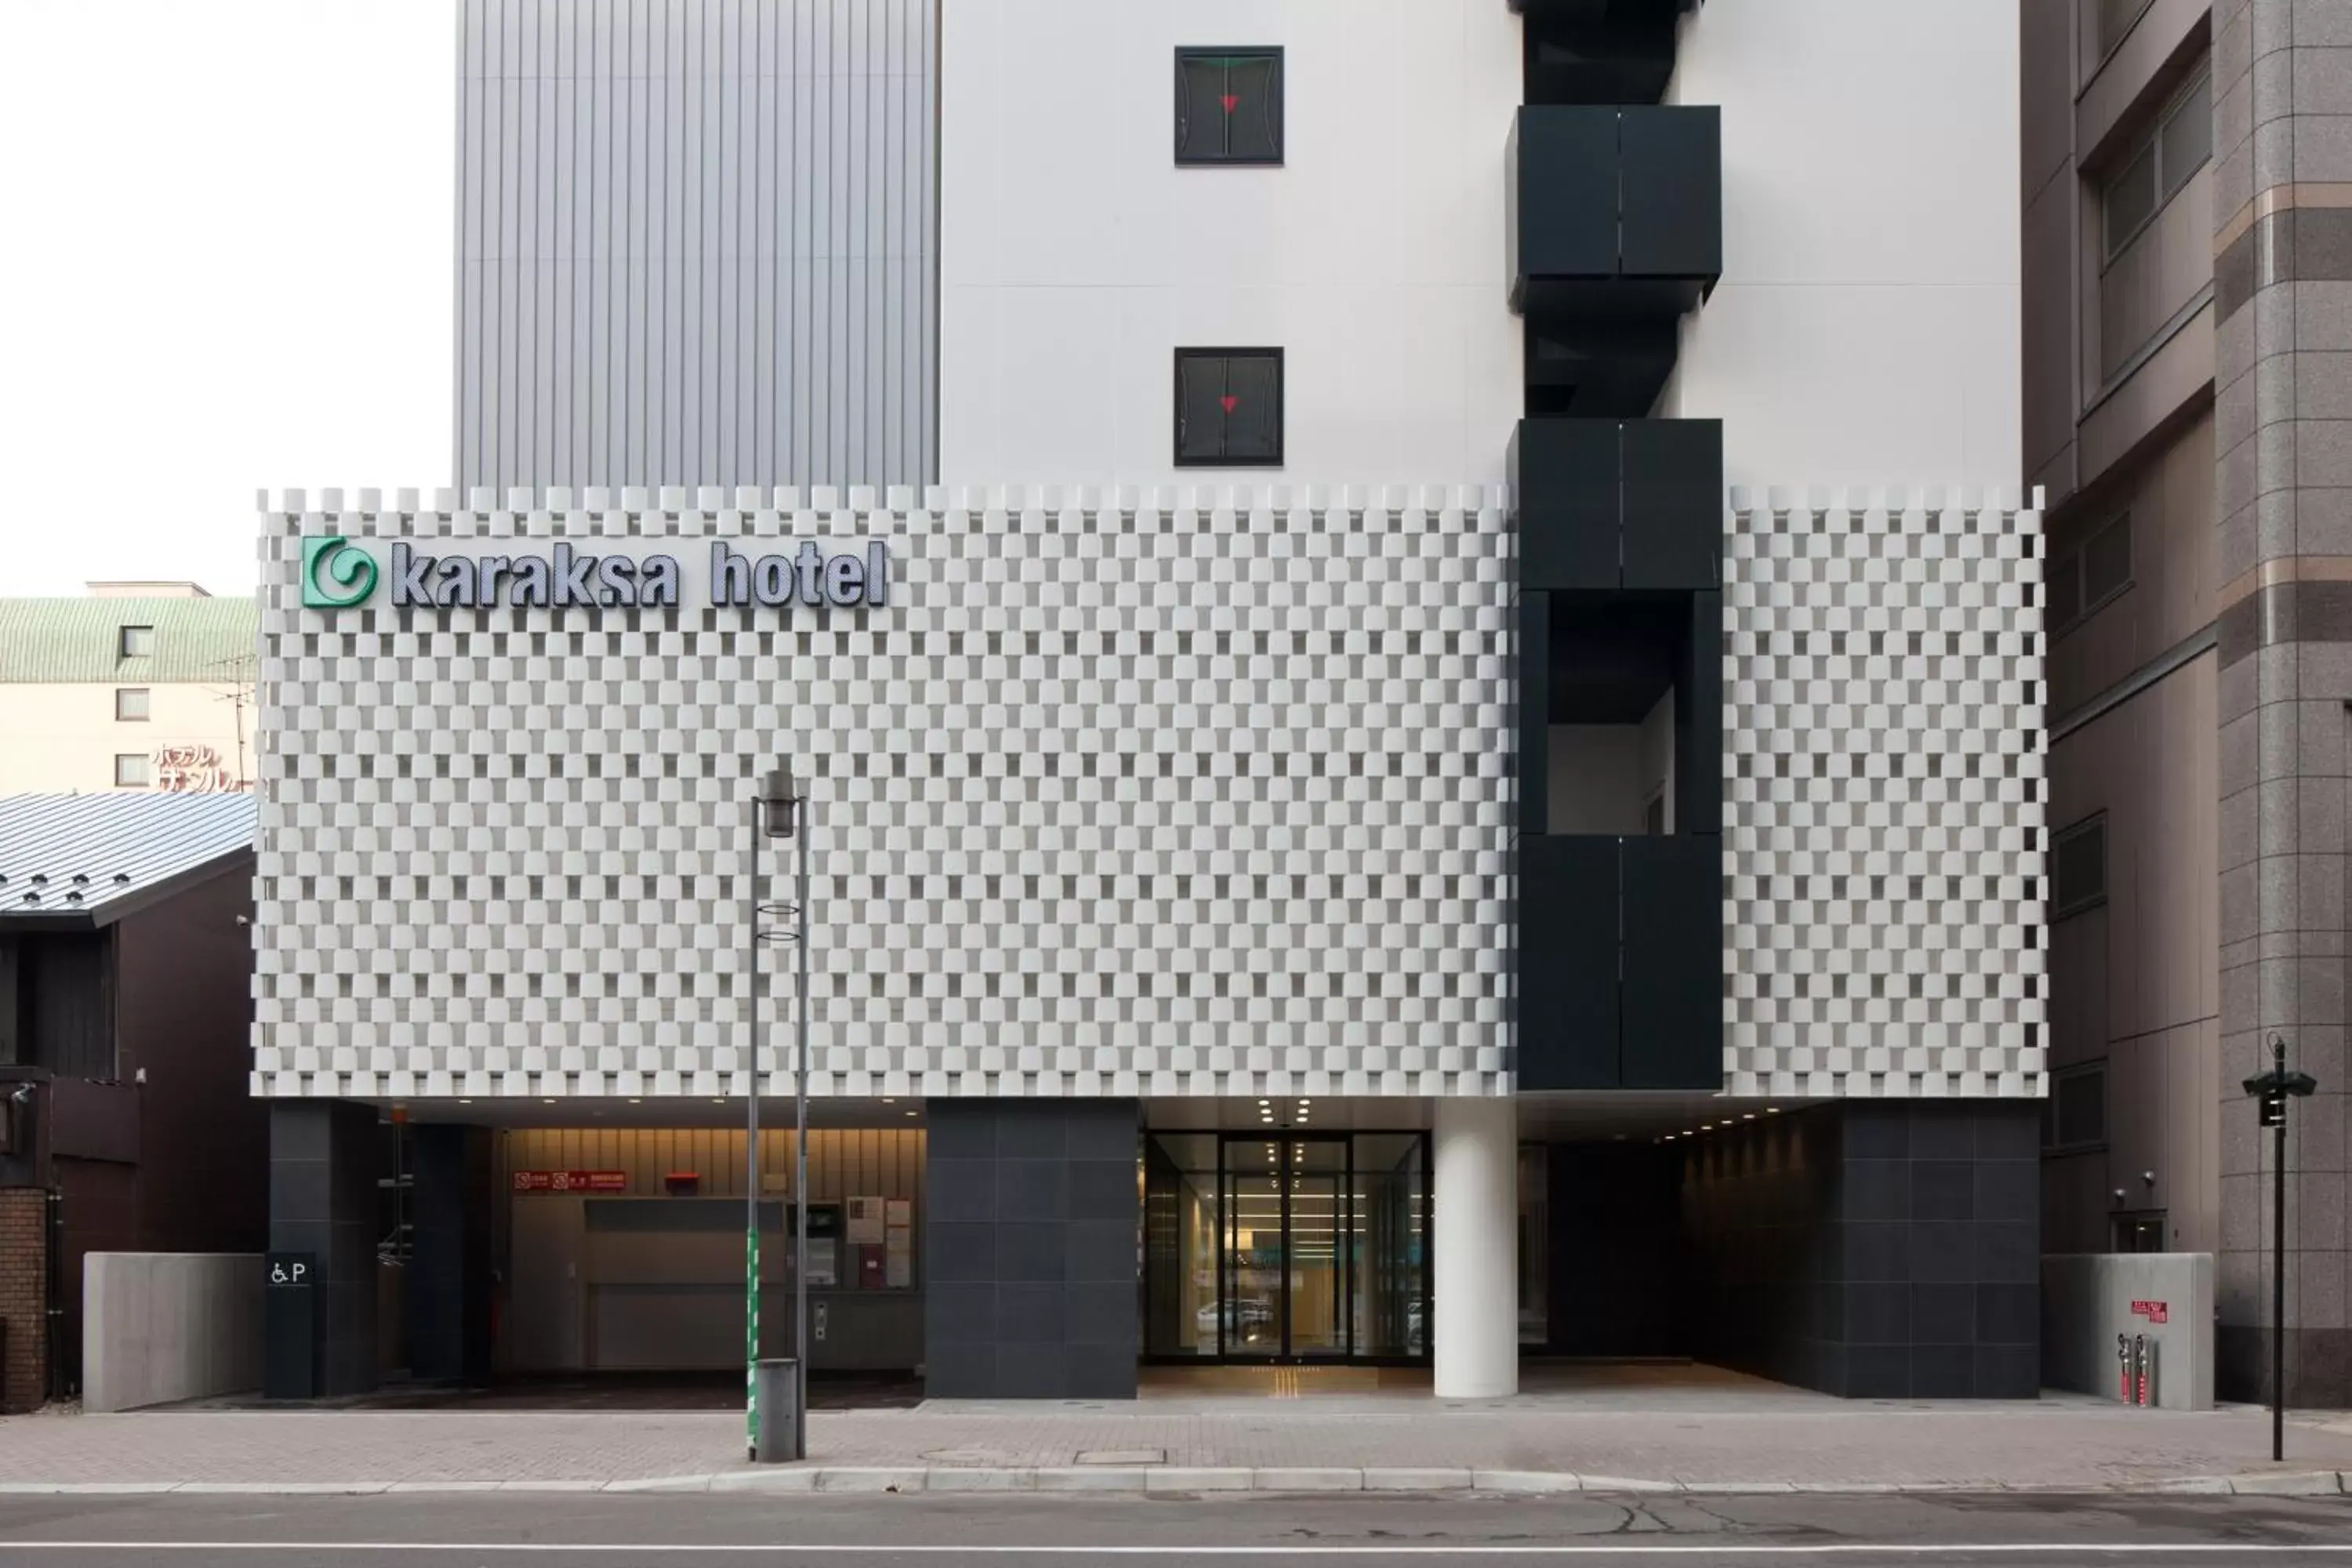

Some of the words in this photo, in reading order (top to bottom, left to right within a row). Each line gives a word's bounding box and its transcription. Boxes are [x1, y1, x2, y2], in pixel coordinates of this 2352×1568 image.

[391, 542, 680, 608] karaksa
[710, 541, 884, 607] hotel
[292, 1263, 305, 1283] P
